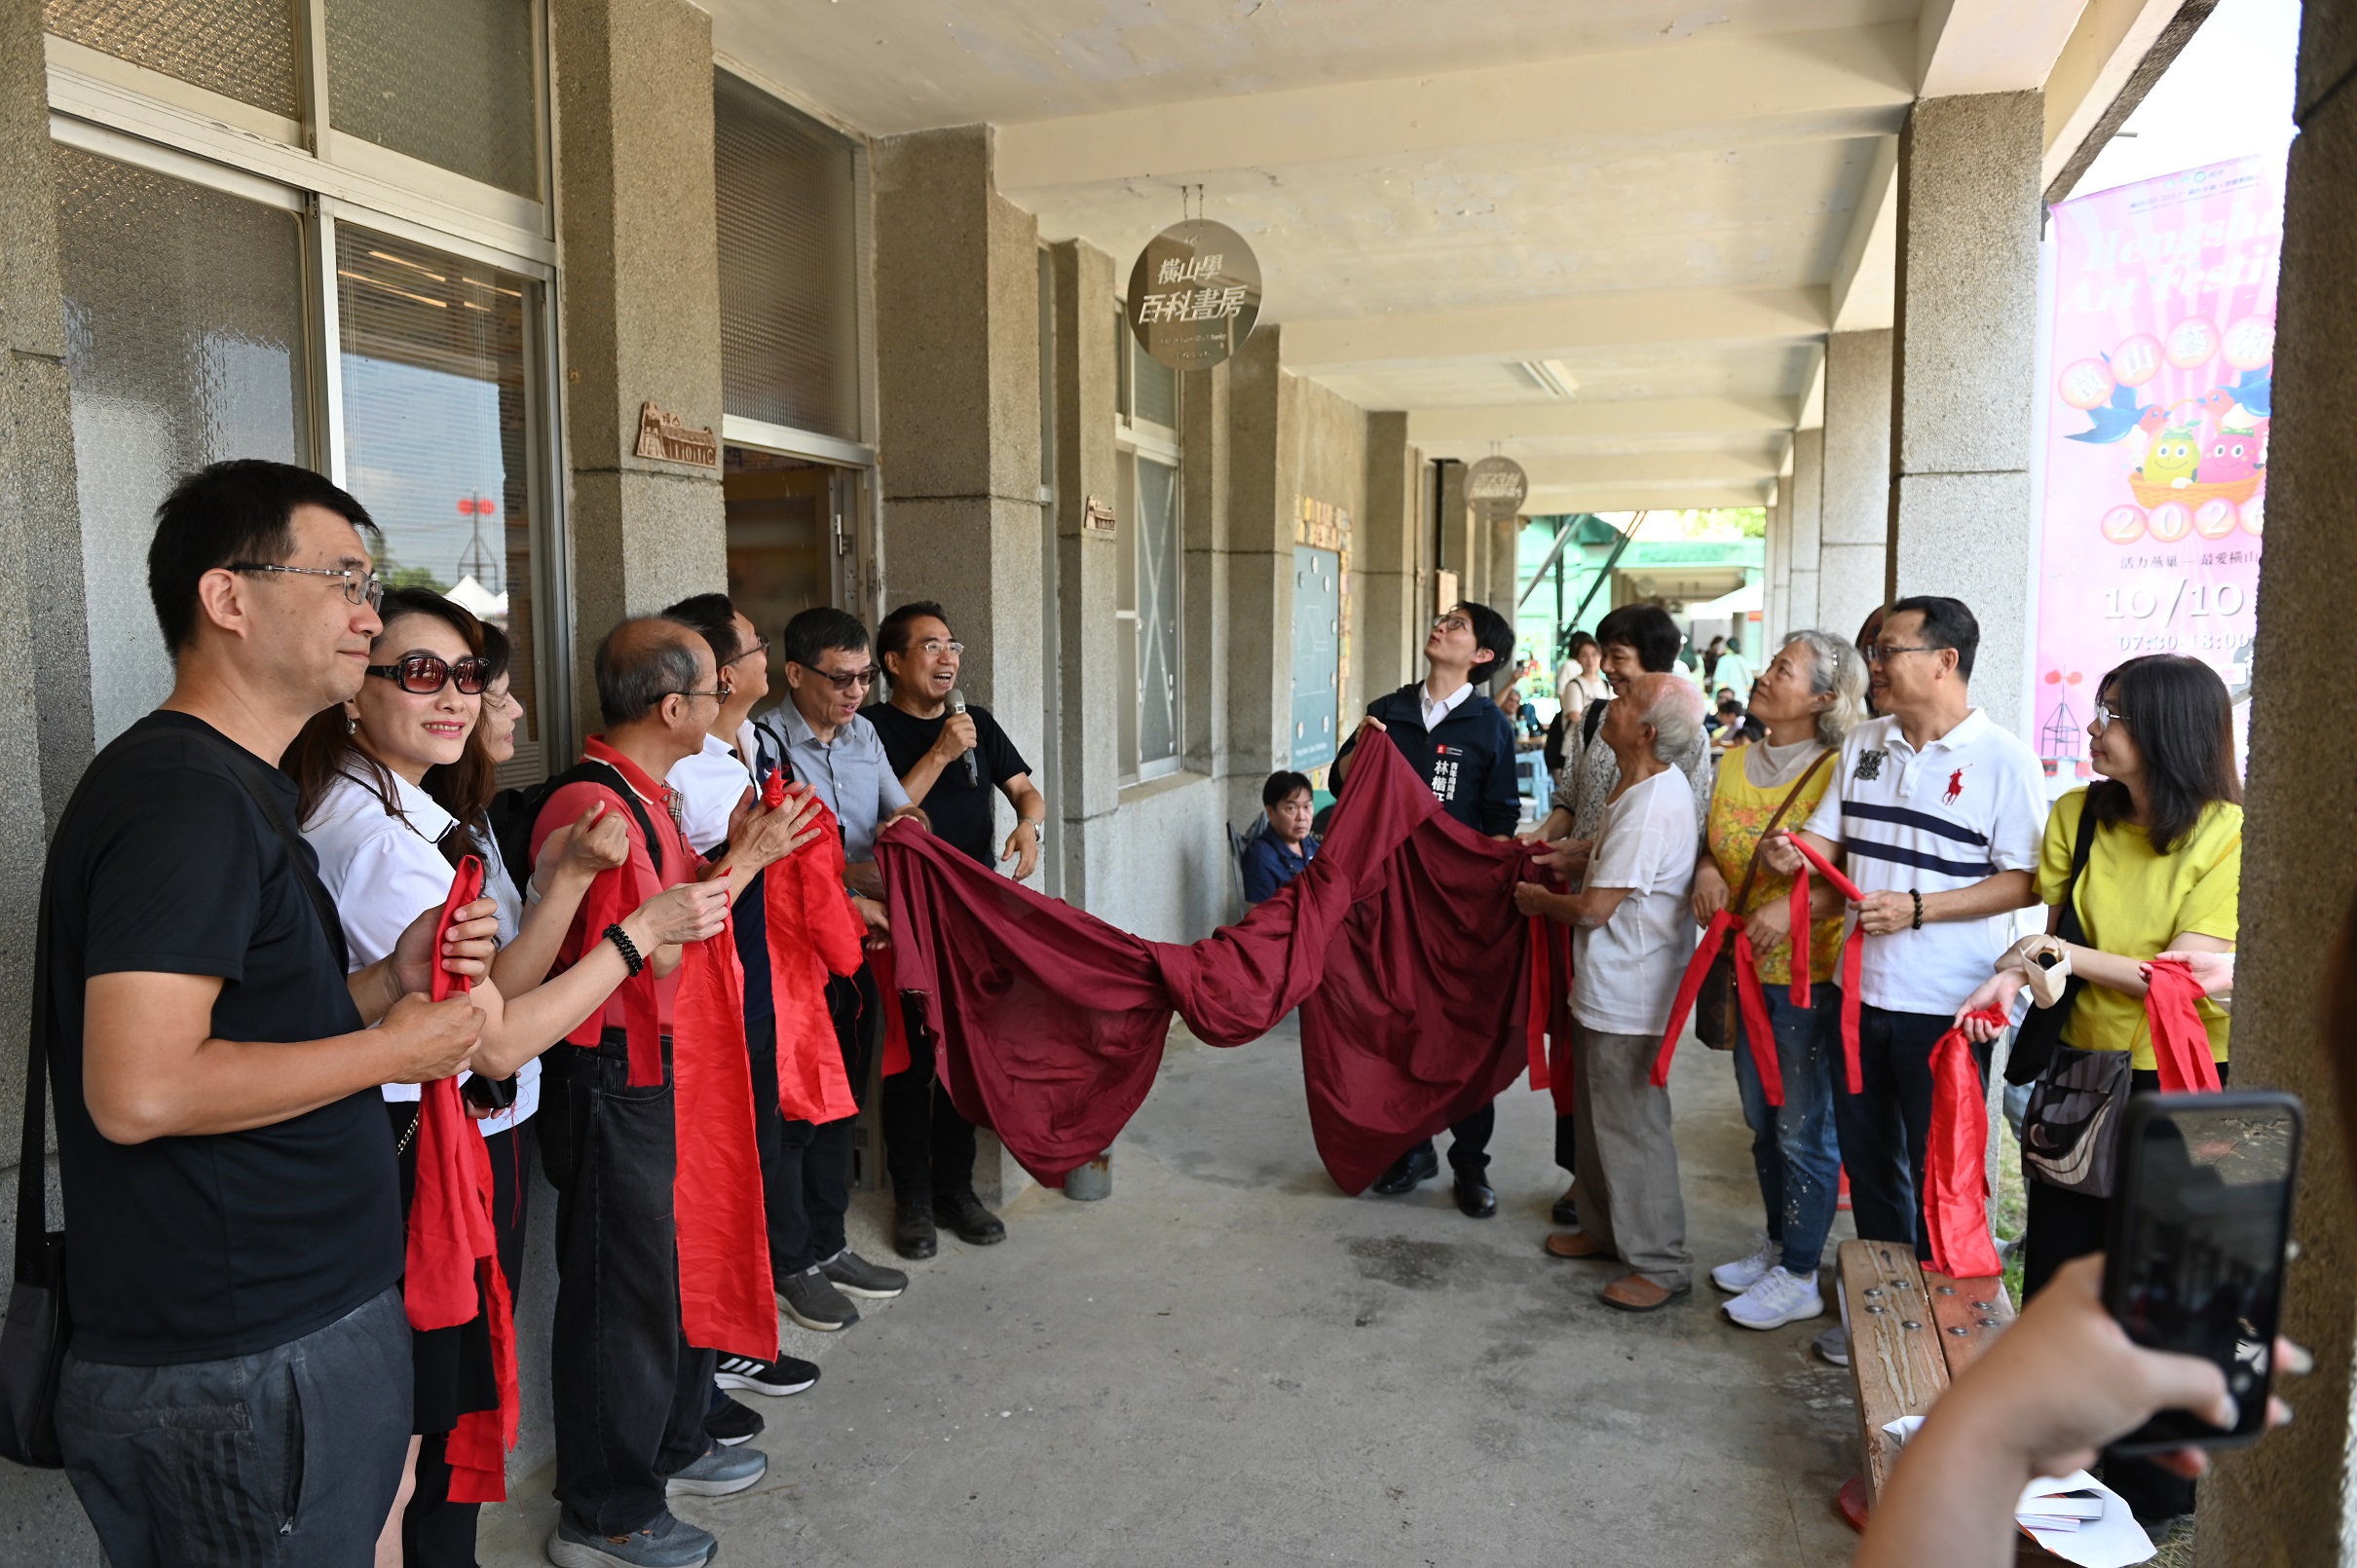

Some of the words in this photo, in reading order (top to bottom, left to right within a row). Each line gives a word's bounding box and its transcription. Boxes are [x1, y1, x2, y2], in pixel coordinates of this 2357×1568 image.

[1138, 283, 1249, 325] 百科書房
[2057, 277, 2140, 313] Art
[2104, 579, 2244, 628] 10/10
